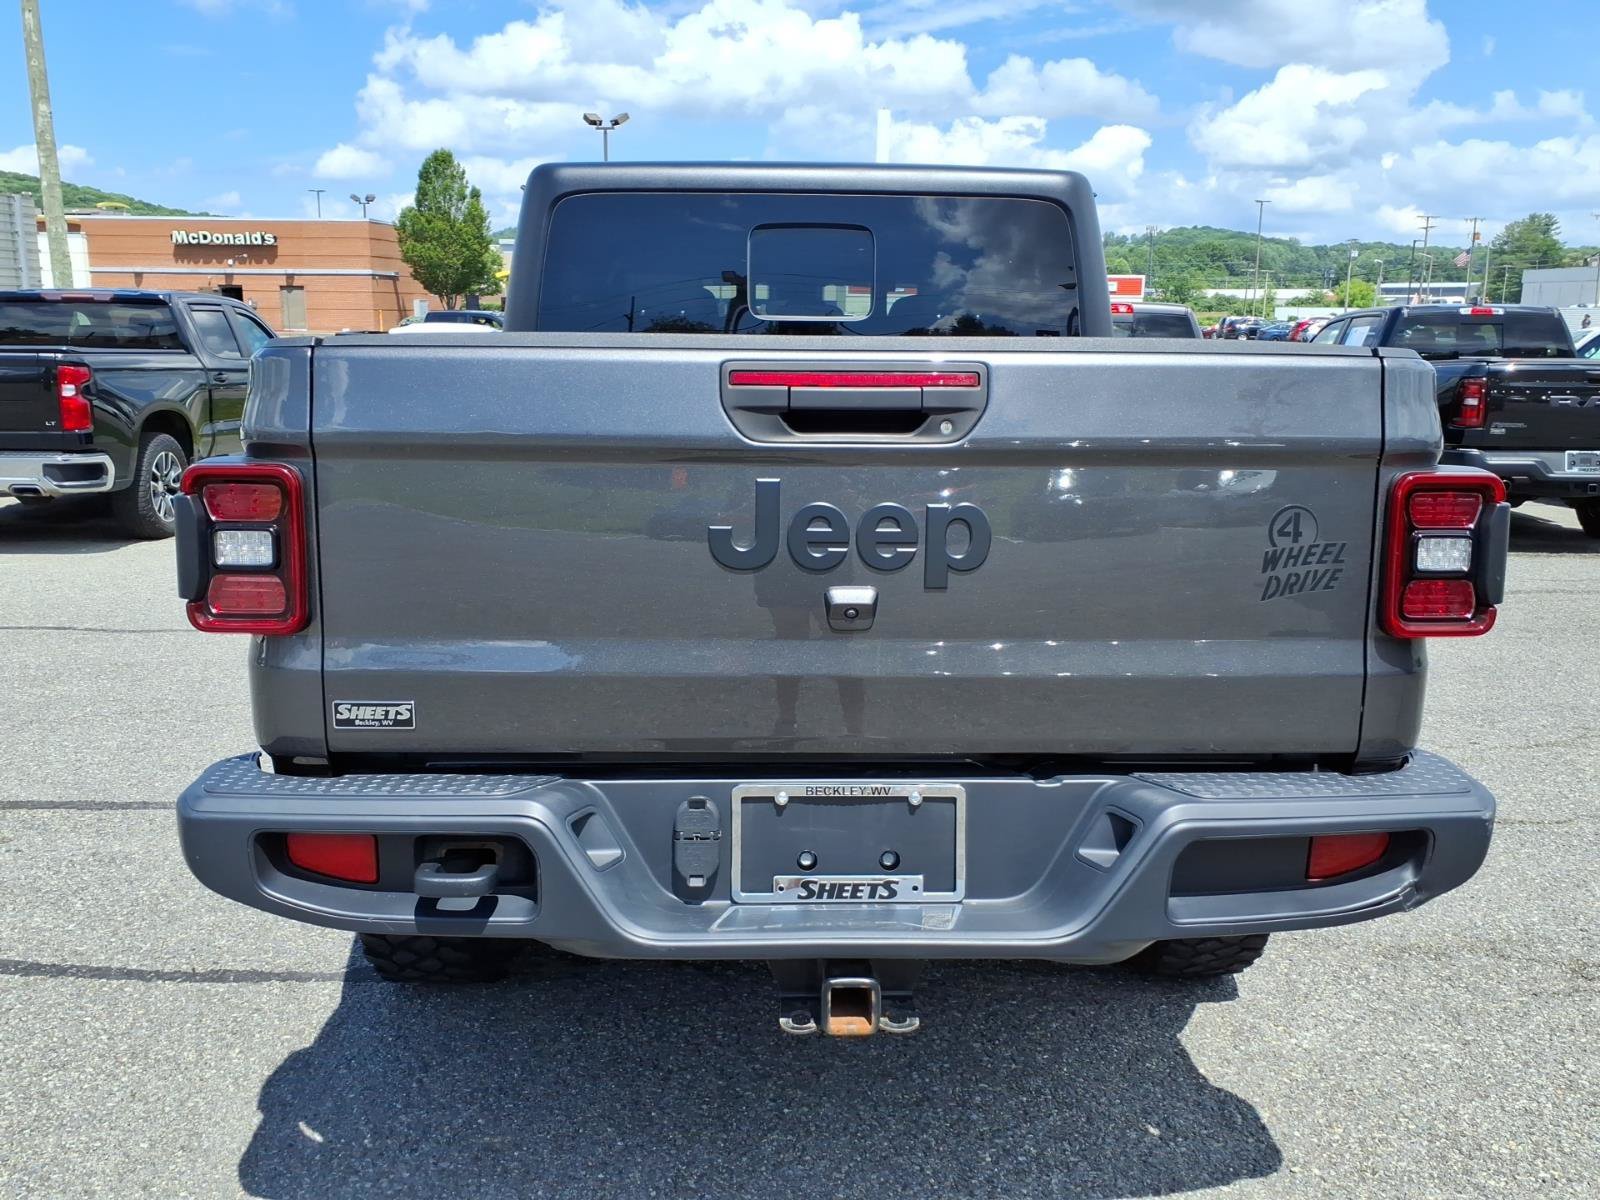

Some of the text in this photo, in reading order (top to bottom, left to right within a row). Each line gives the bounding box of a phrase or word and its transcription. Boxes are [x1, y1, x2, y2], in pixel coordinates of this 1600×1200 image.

[171, 230, 274, 246] McDonald's
[708, 478, 991, 590] Jeep
[1277, 512, 1303, 543] 4
[1261, 543, 1347, 574] WHEEL
[1260, 568, 1344, 601] DRIVE
[336, 704, 412, 720] SHEETS
[797, 881, 898, 900] SHEETS
